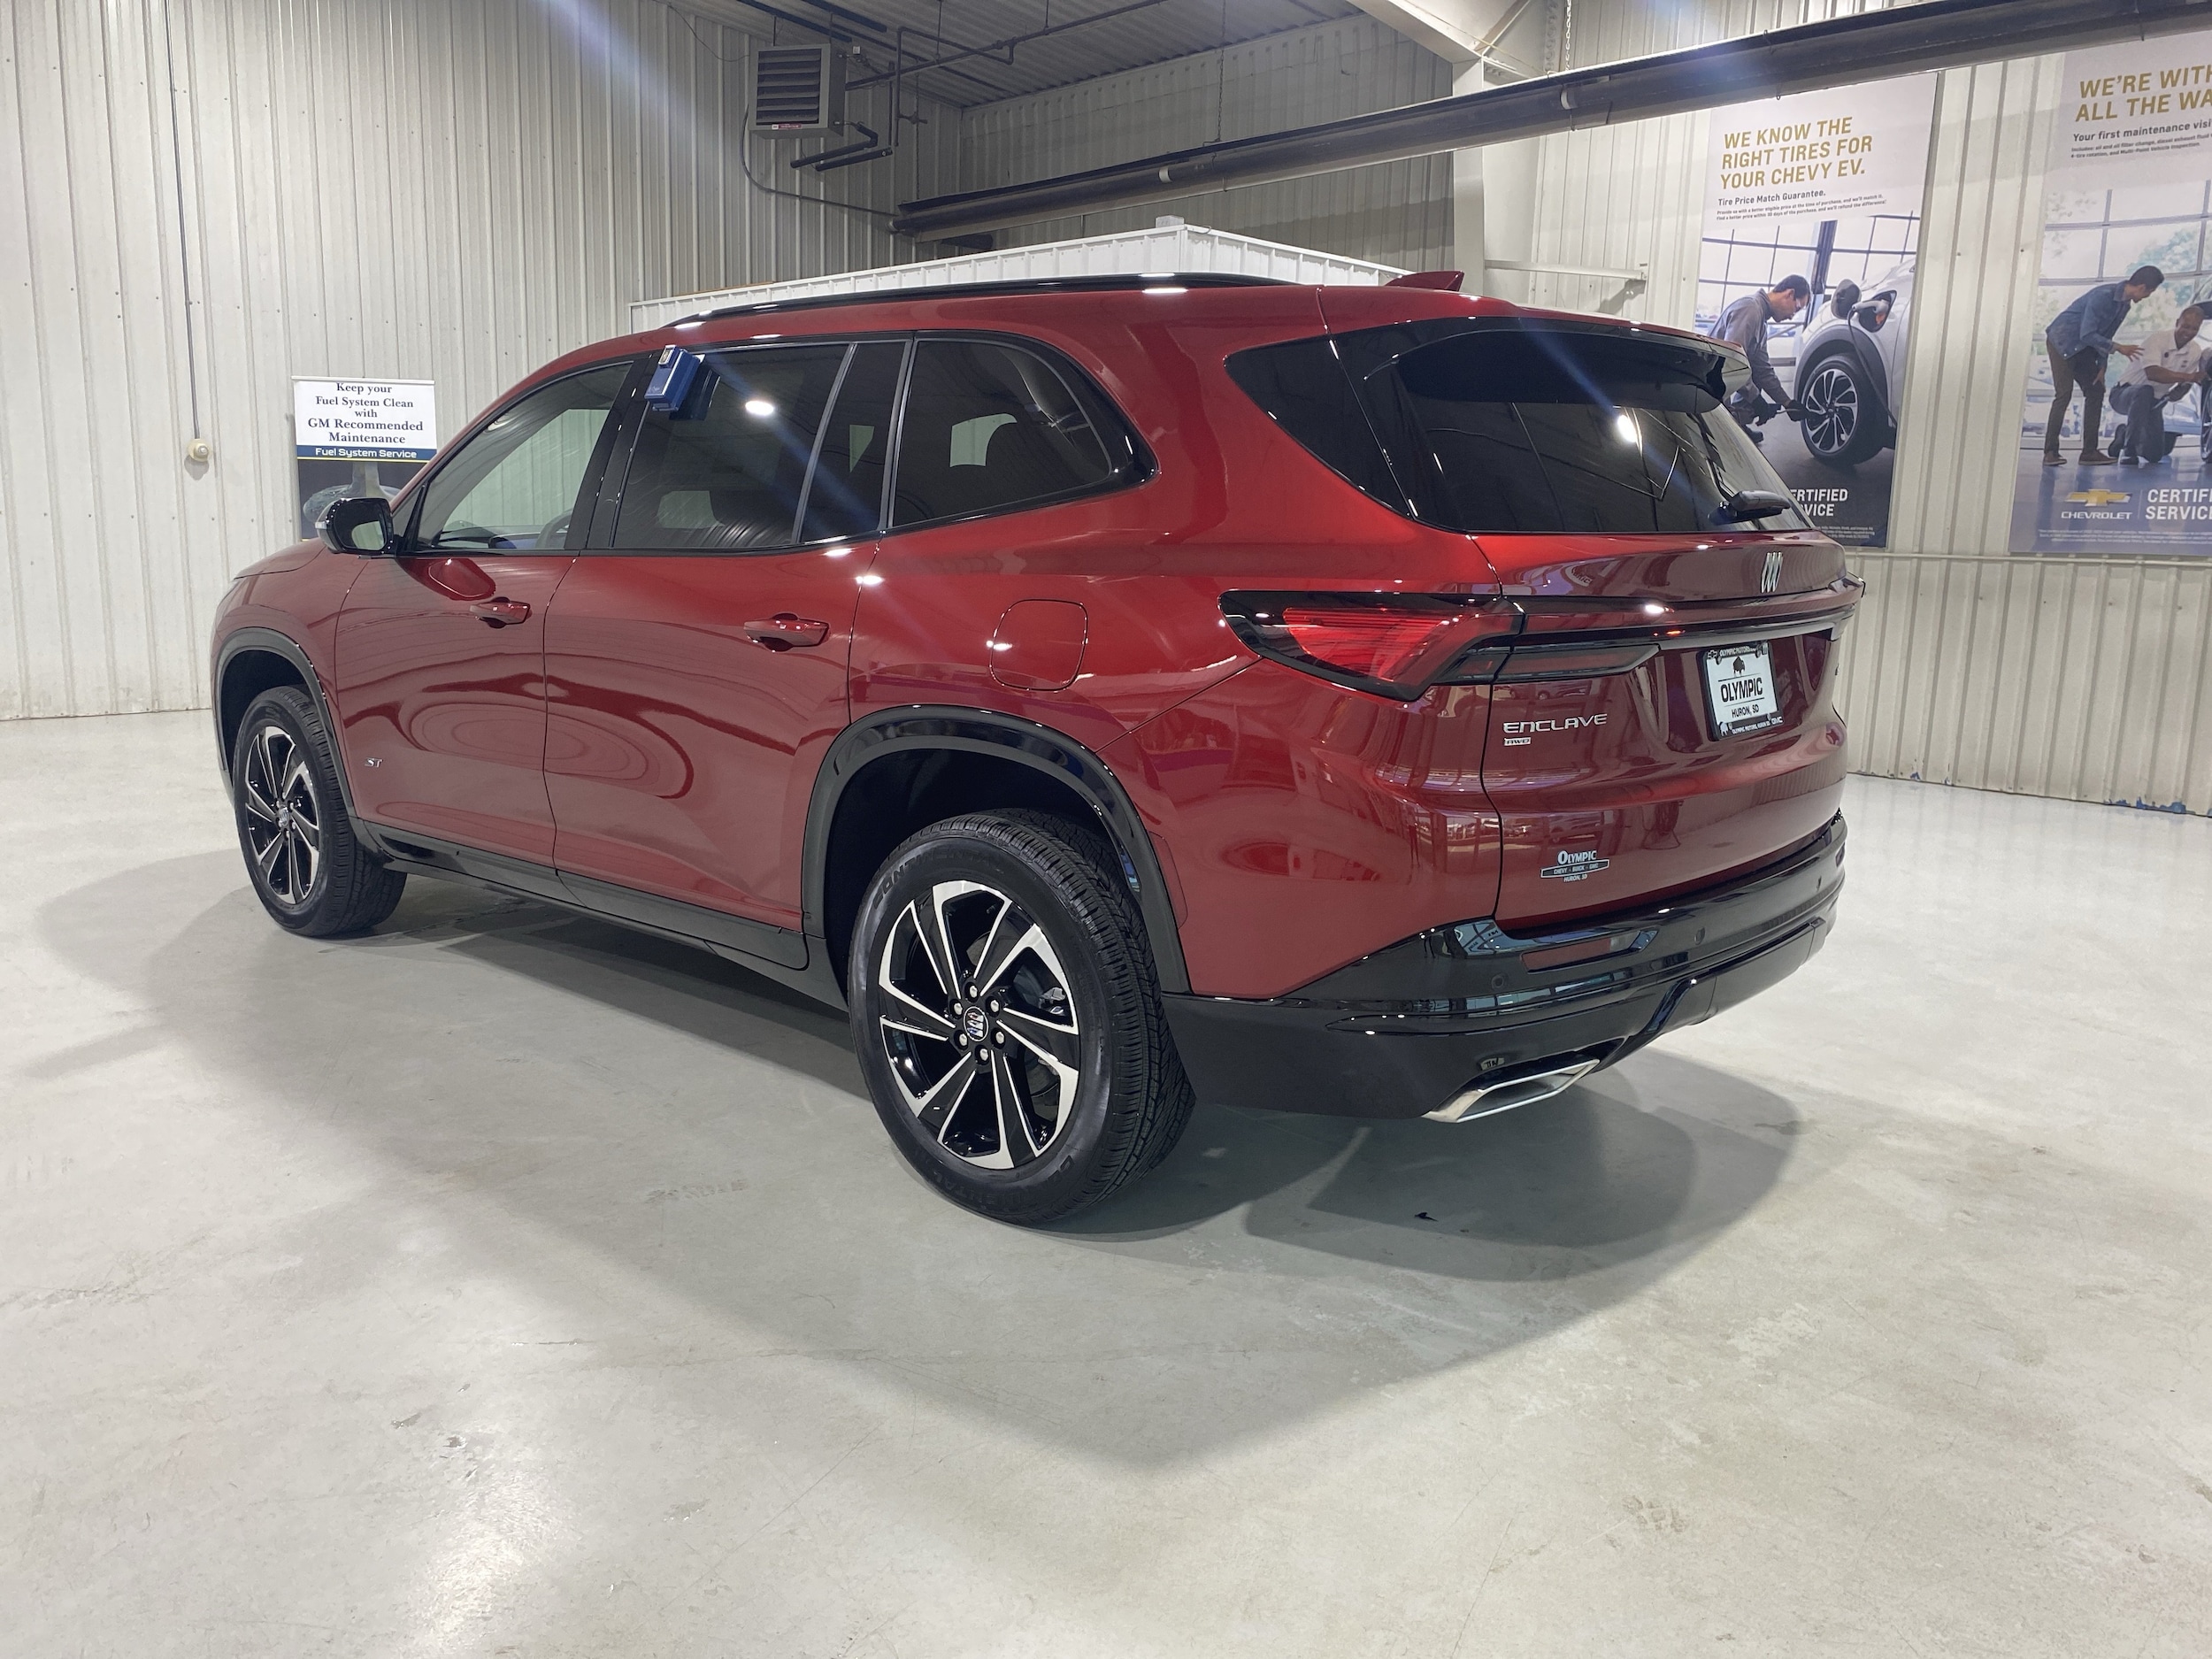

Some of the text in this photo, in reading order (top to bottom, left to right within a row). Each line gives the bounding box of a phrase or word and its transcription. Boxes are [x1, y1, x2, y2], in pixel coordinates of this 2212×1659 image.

[2080, 73, 2152, 98] WE'RE
[2075, 88, 2212, 122] ALL THE WA
[1724, 117, 1853, 149] WE KNOW THE
[2098, 130, 2120, 140] first
[2123, 123, 2191, 137] maintenance
[2193, 118, 2212, 129] visi
[1722, 135, 1872, 170] RIGHT TIRES FOR
[1720, 158, 1865, 189] YOUR CHEVY EV.
[1718, 197, 1732, 206] Tire
[1756, 193, 1780, 203] Match
[1782, 190, 1826, 201] Guarantee.
[336, 382, 392, 396] Keep your
[315, 396, 413, 408] Fuel System Clean
[354, 409, 378, 418] with
[308, 418, 424, 431] GM Recommended
[328, 432, 406, 443] Maintenance
[315, 448, 417, 458] Fuel System Service
[1790, 488, 1848, 502] RTIFIED
[1801, 503, 1835, 517] VICE
[2061, 511, 2132, 520] CHEVROLET
[1720, 677, 1763, 703] OLYMPIC
[1732, 703, 1760, 718] HURON, SD
[1503, 713, 1608, 733] ENCLAVE
[365, 757, 383, 768] ST
[1557, 850, 1597, 864] OLYMPIC
